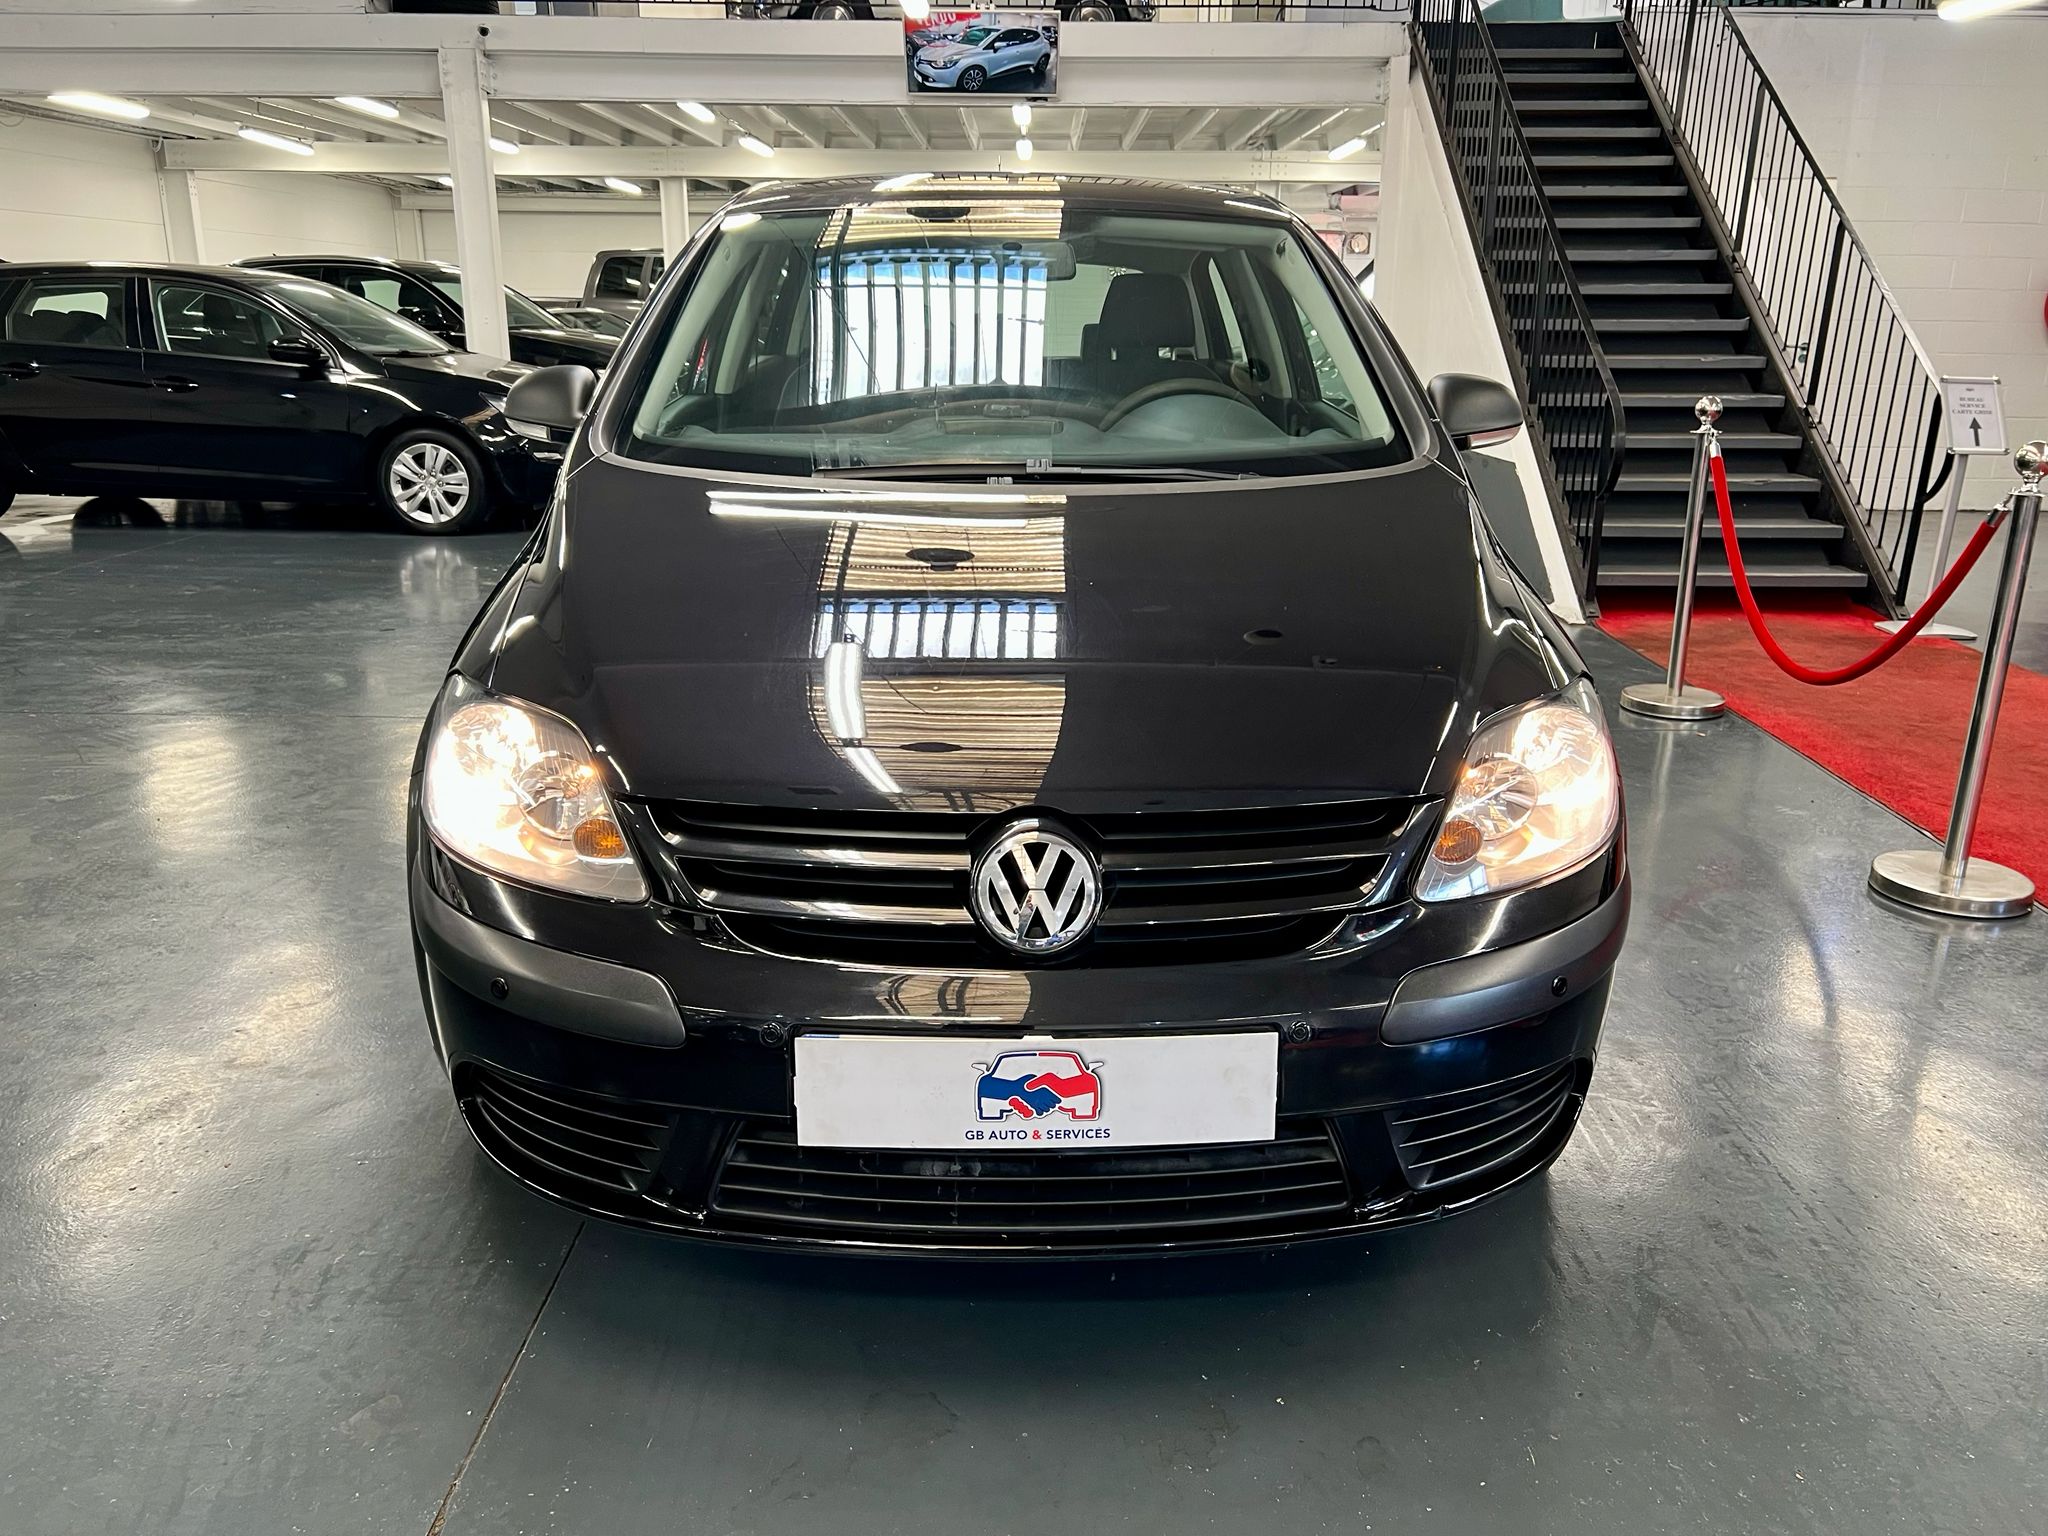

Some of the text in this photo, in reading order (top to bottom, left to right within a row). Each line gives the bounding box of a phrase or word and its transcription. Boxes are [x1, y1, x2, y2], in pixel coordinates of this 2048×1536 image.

[977, 829, 1097, 951] VW
[965, 1128, 1111, 1140] GB AUTO & SERVICES
